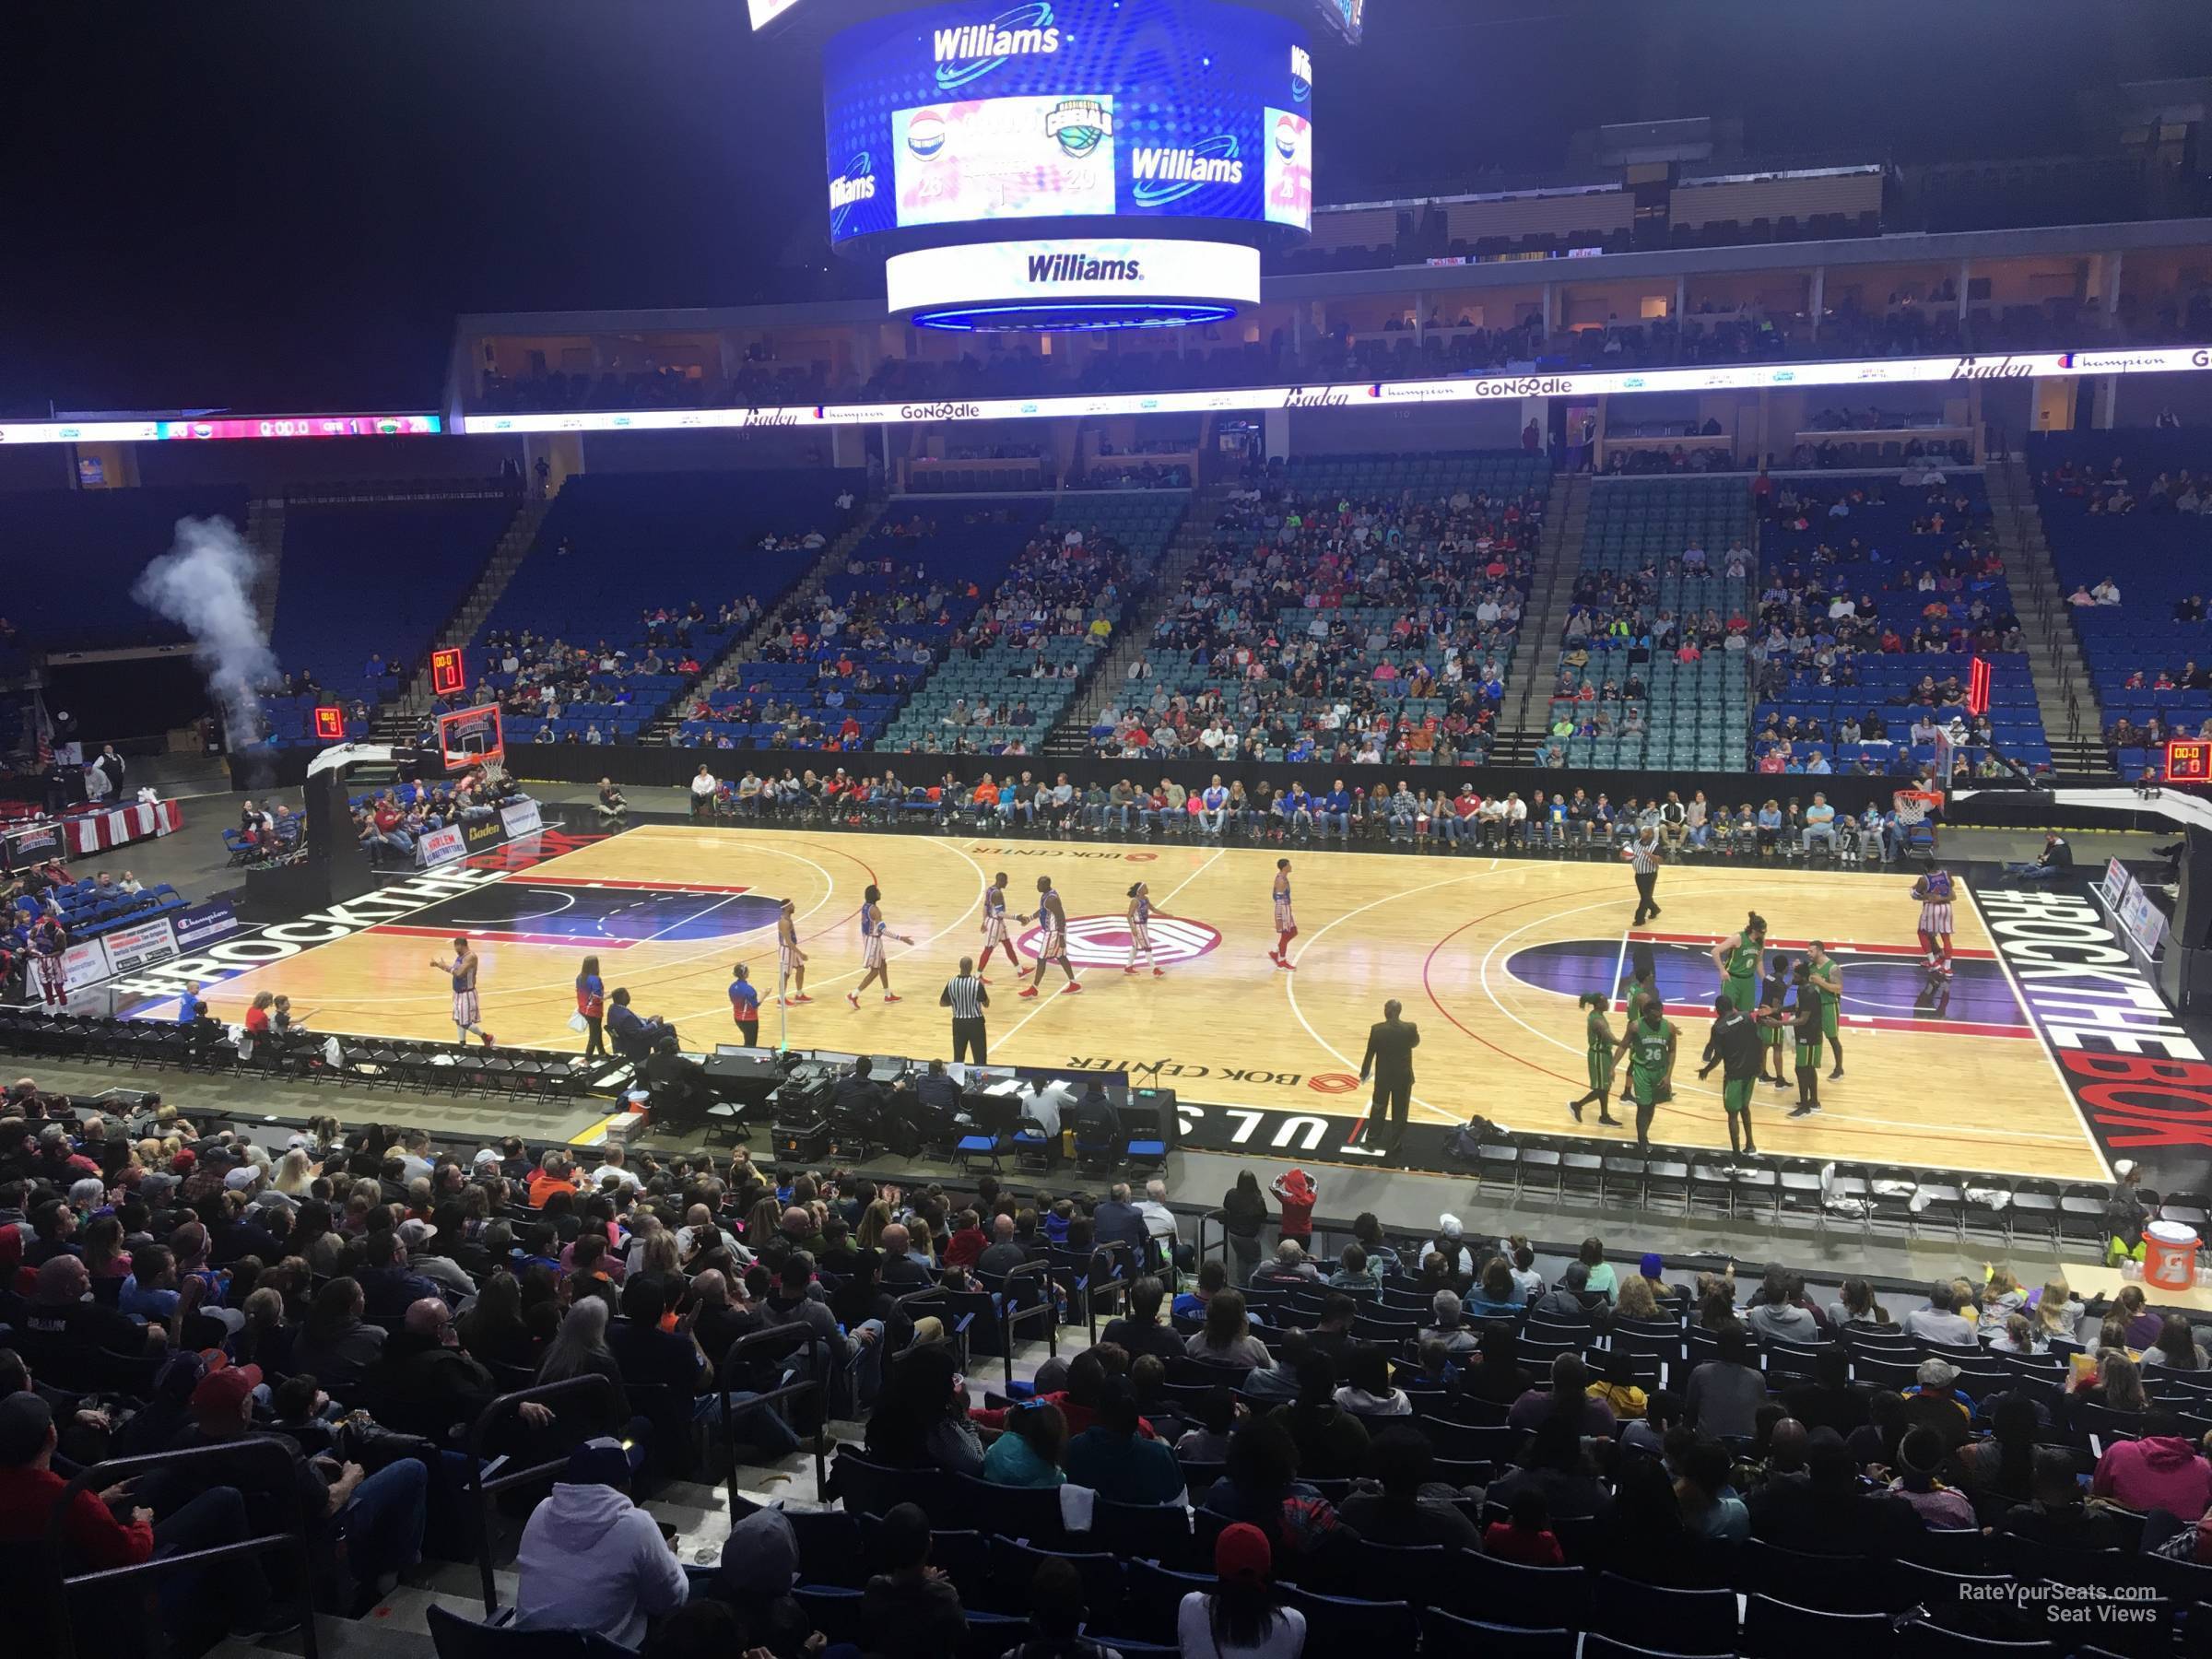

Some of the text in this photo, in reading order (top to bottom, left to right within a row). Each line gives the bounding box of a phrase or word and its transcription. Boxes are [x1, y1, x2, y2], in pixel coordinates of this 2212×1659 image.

[934, 26, 1060, 62] Williams
[1132, 147, 1243, 185] Williams
[1028, 254, 1140, 282] Williams
[1950, 356, 2033, 380] Baden
[1284, 385, 1349, 407] Baden
[1475, 378, 1572, 398] GoNoodle
[743, 407, 796, 427] Baden
[900, 402, 980, 421] GoNoodle
[349, 420, 358, 433] 1
[446, 666, 456, 685] 0
[469, 823, 500, 841] Baden
[428, 834, 455, 850] HARLEM
[177, 911, 229, 929] Champion
[1645, 1048, 1662, 1061] 26
[1066, 1056, 1301, 1086] BOK CENTER
[2166, 1253, 2183, 1269] G
